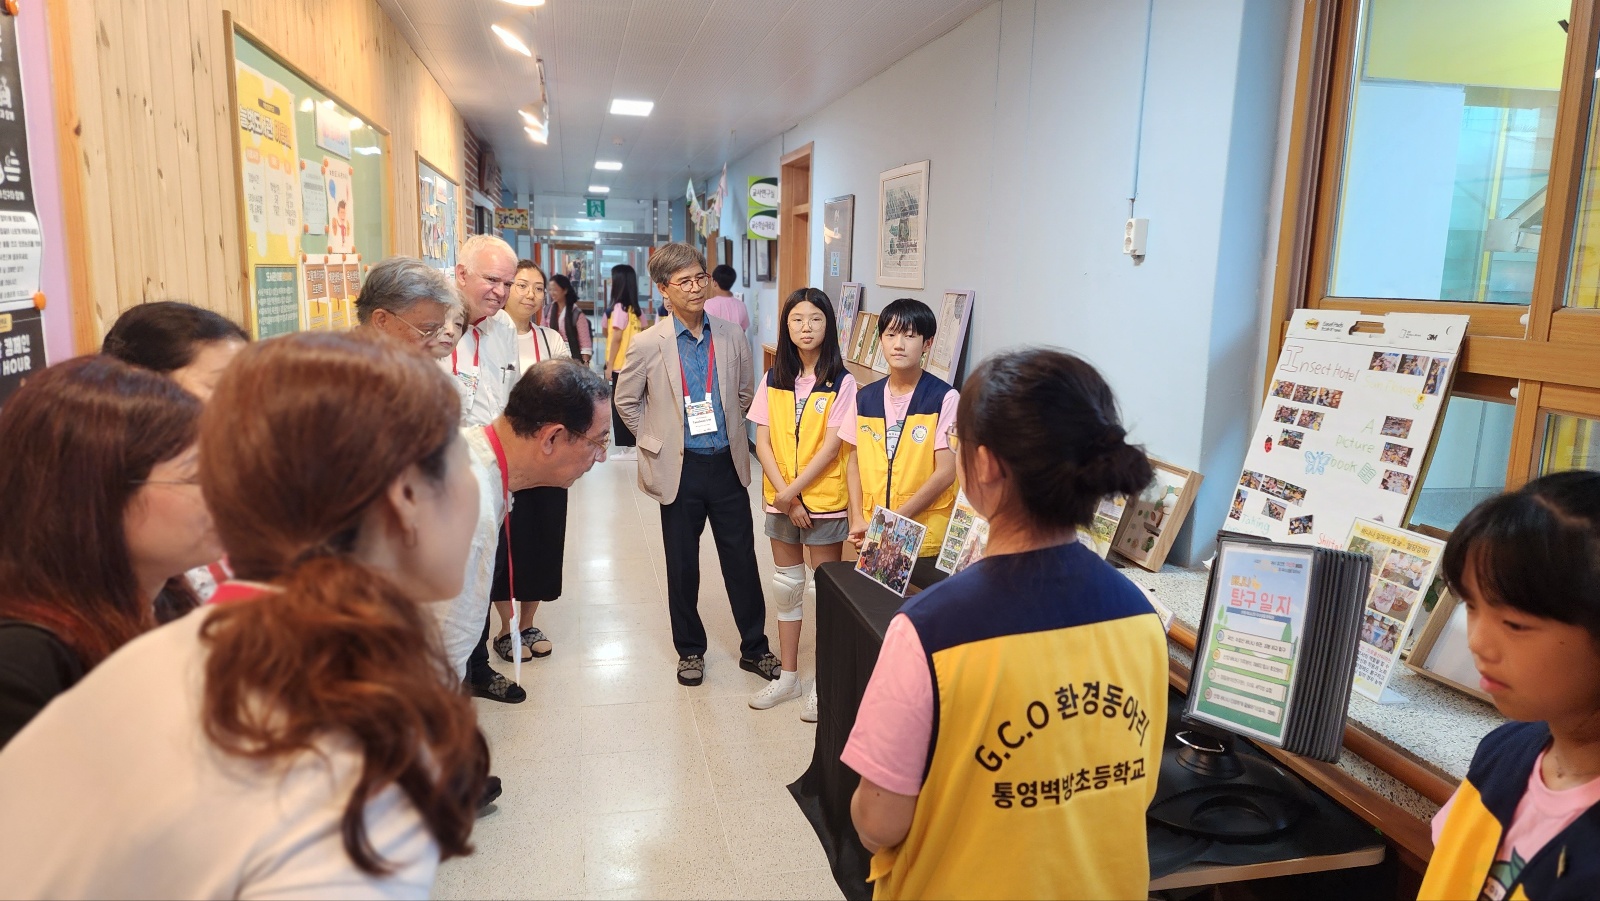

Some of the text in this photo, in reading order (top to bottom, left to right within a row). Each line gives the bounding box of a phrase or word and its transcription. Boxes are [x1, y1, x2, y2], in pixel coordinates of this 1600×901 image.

[1427, 333, 1438, 341] 3M
[2, 355, 31, 376] HOUR
[1280, 345, 1361, 382] Insect Hotel
[1361, 418, 1375, 434] A
[1335, 434, 1376, 454] picture
[1241, 513, 1271, 535] Taking
[1231, 587, 1257, 609] 탐구
[1260, 592, 1292, 616] 일지
[974, 680, 1150, 773] G.C.O 환경동아리
[991, 757, 1146, 809] 통영벽방초등학교
